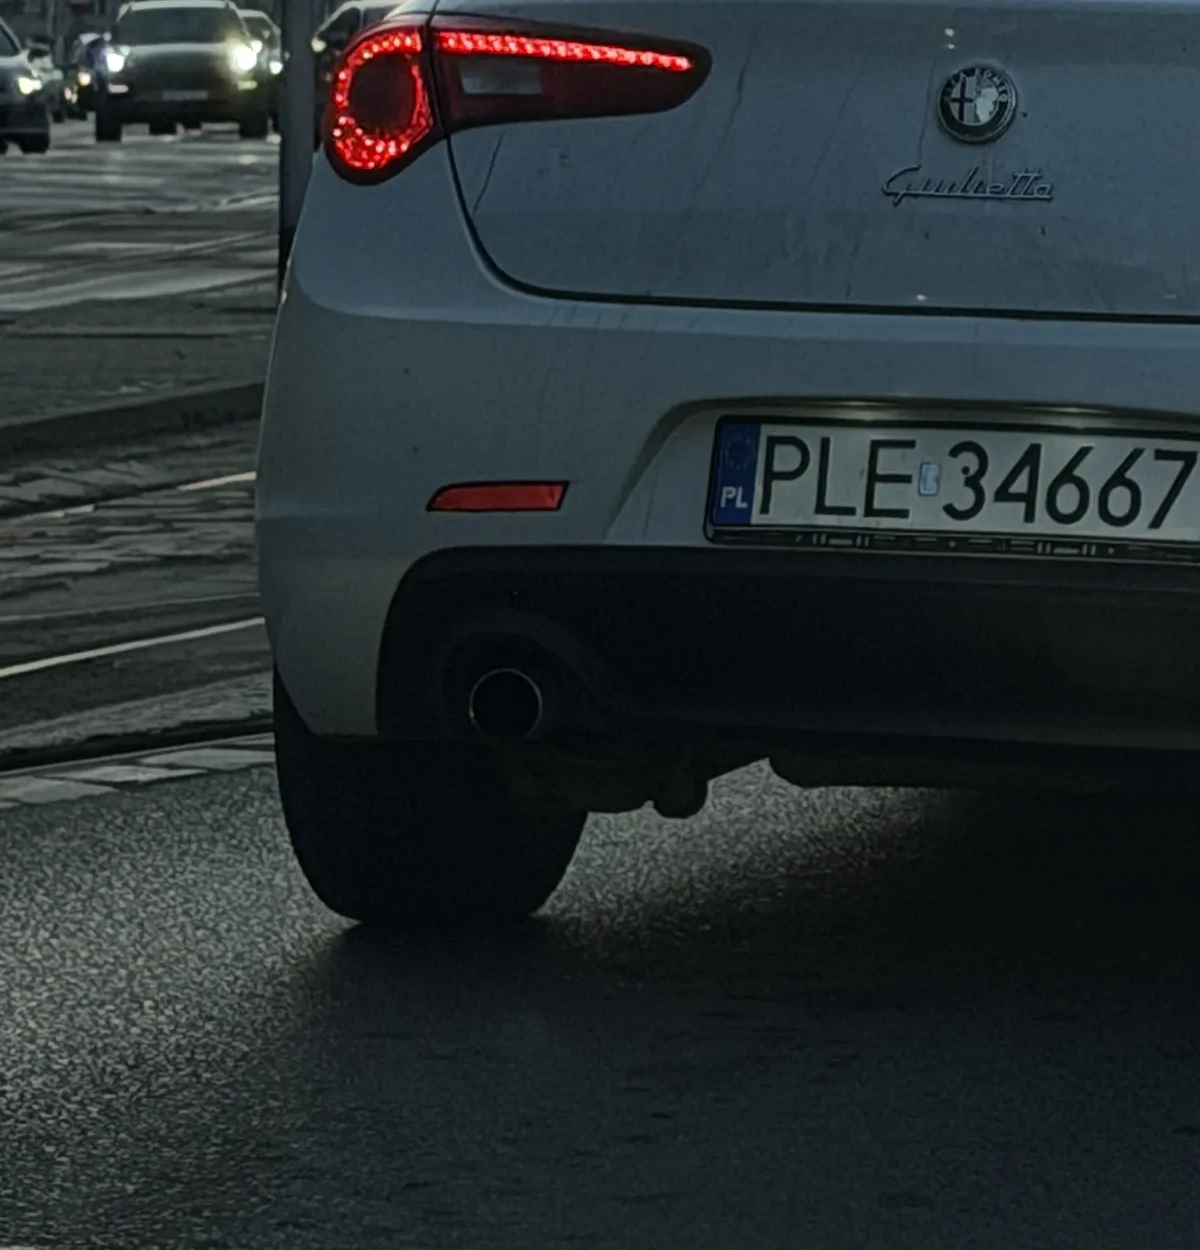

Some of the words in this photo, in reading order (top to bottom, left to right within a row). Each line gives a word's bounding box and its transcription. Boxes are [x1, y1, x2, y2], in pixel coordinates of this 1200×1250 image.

[882, 164, 1054, 207] Giulietta
[719, 485, 750, 510] PL
[759, 434, 916, 519] PLE
[942, 440, 1199, 530] 34667
